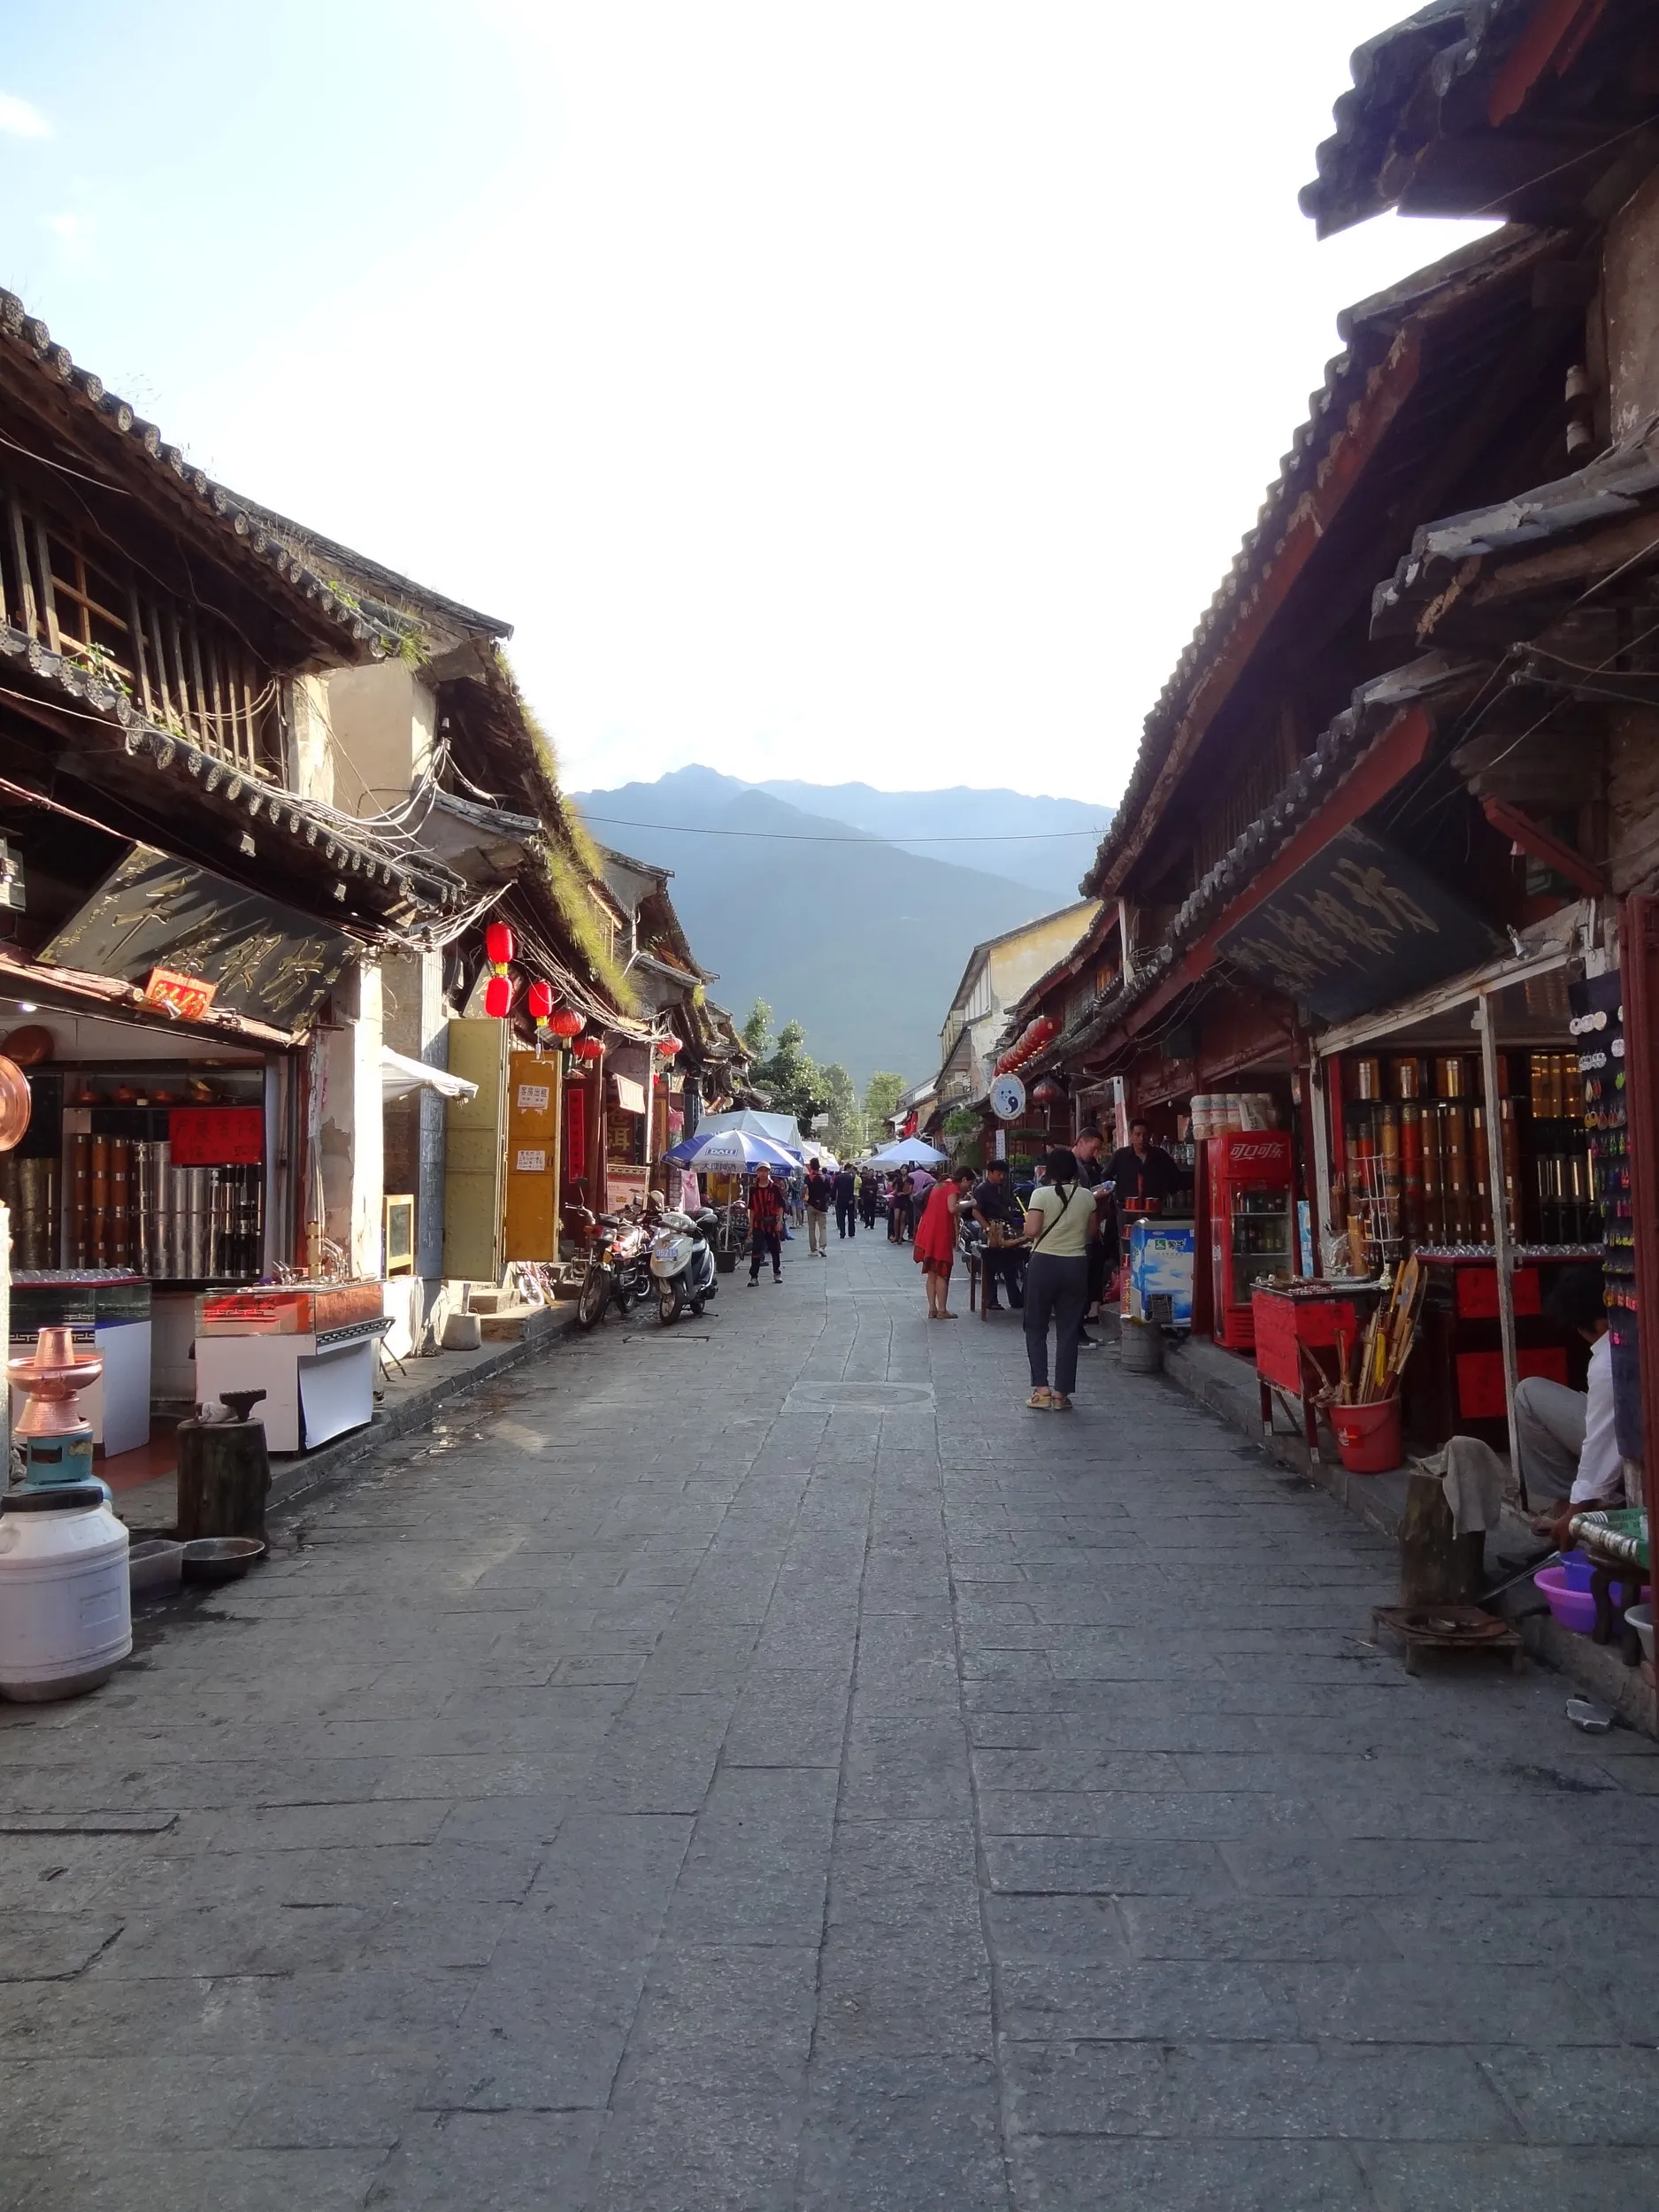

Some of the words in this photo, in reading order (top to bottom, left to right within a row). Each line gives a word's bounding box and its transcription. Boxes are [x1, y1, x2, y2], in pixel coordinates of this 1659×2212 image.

[521, 1087, 547, 1097] 客房出租
[1231, 1142, 1286, 1160] 可口可乐
